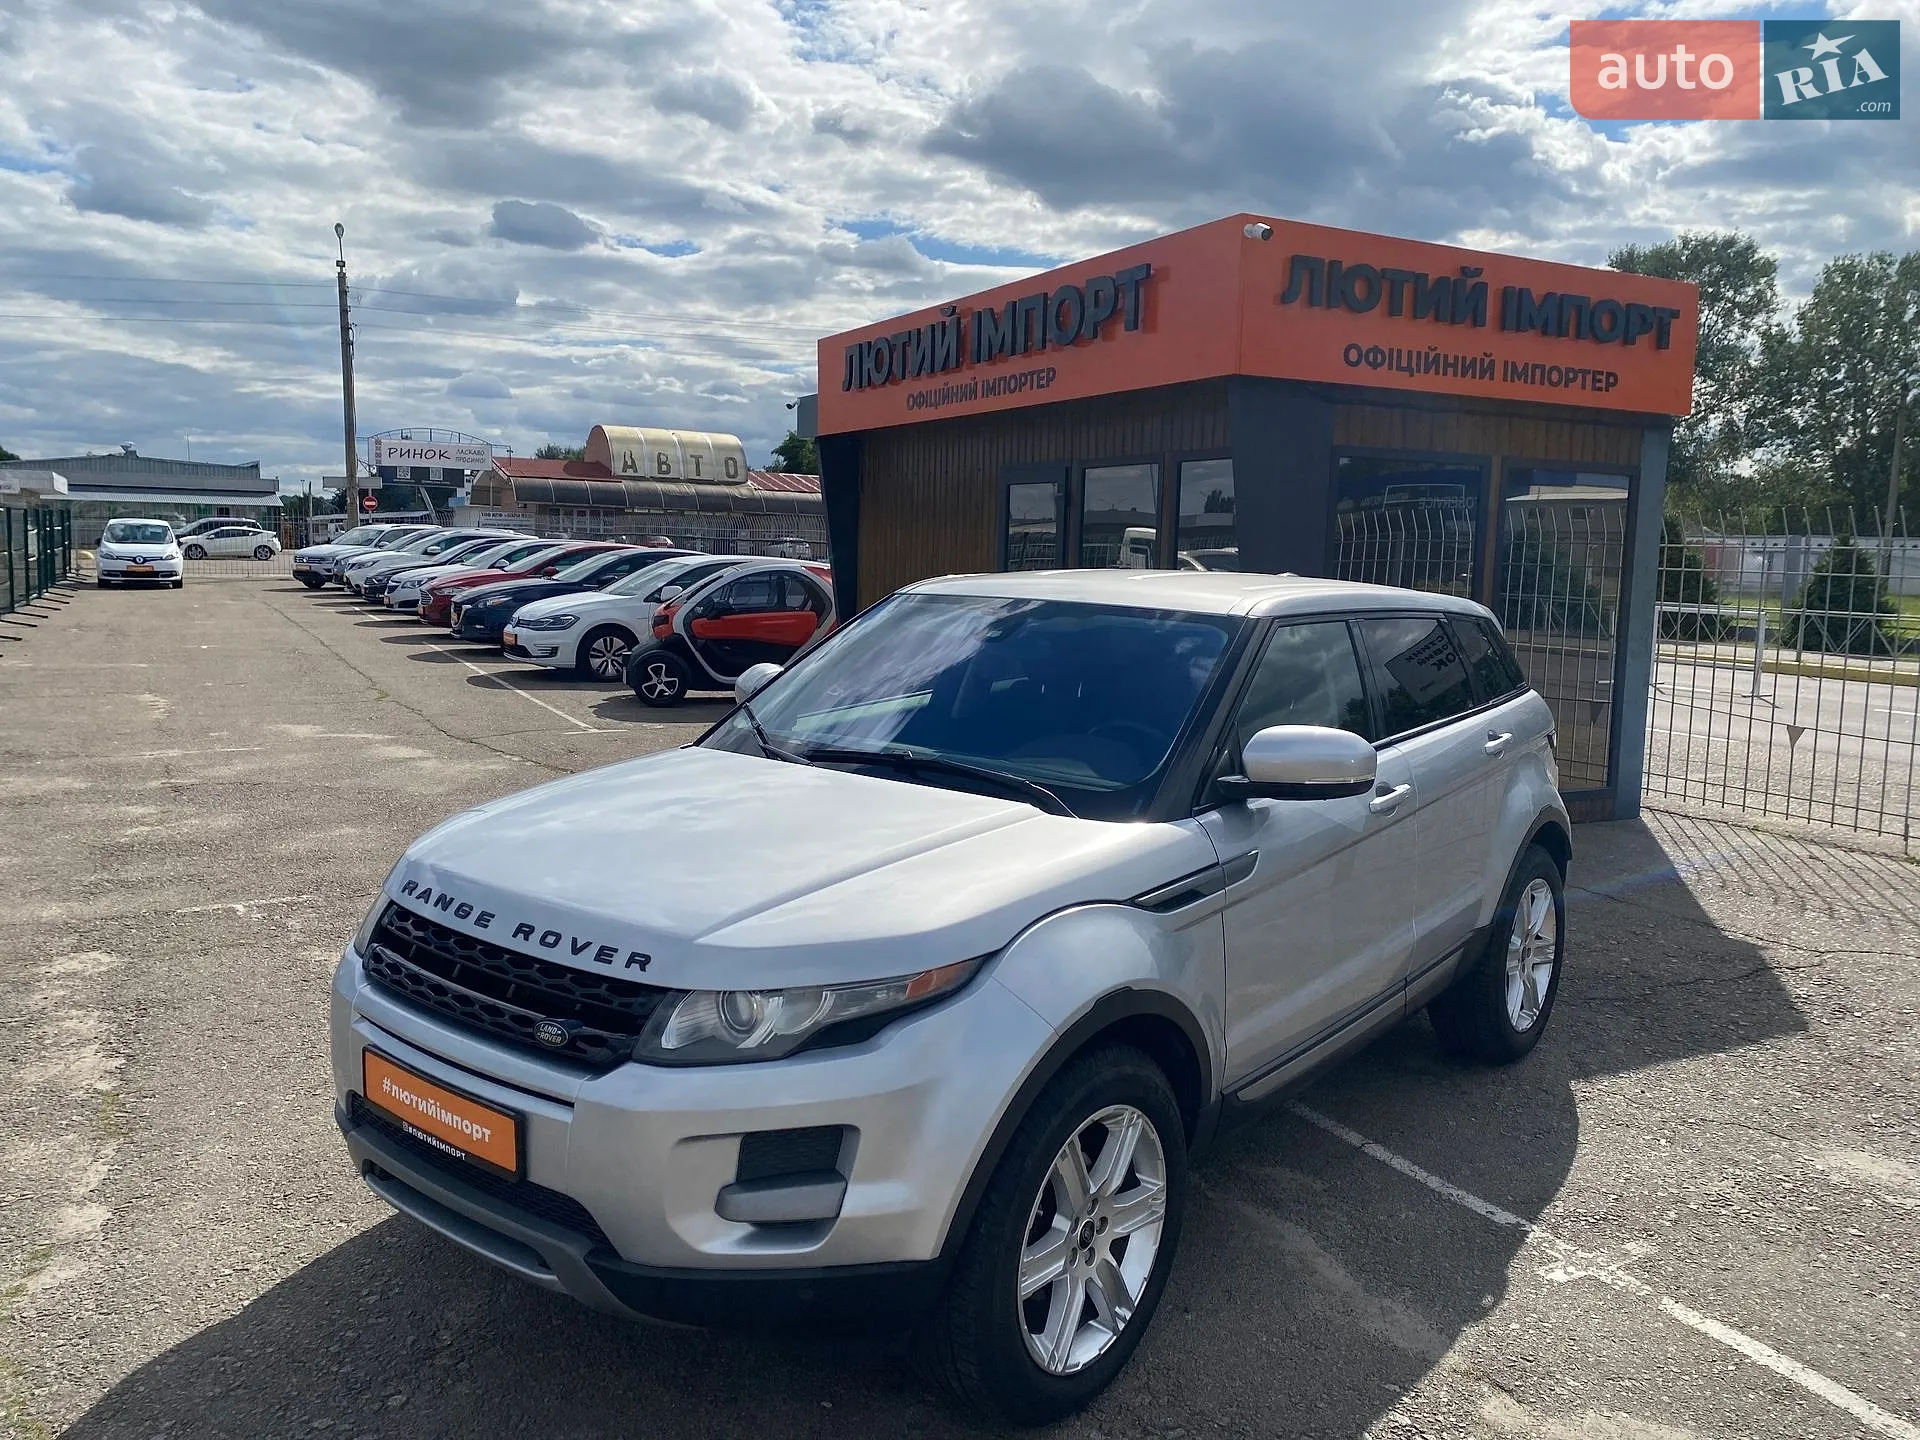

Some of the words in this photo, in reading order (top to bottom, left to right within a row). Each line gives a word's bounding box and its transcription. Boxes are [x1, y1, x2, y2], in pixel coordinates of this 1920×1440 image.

[842, 305, 961, 391] ЛЮТИЙ
[971, 263, 1151, 363] ІМПОРТ
[1281, 254, 1489, 327] ЛЮТИЙ
[1502, 286, 1680, 350] ІМПОРТ
[906, 375, 978, 411] ОФІЦІЙНИЙ
[981, 367, 1056, 397] ІМПОРТЕР
[1343, 343, 1495, 381] ОФІЦІЙНИЙ
[1503, 360, 1619, 392] ІМПОРТЕР
[387, 447, 451, 460] РИНОК
[622, 450, 738, 479] АВТО
[400, 879, 496, 928] RANGE
[511, 922, 652, 972] ROVER
[382, 1077, 491, 1143] #лютийімпорт
